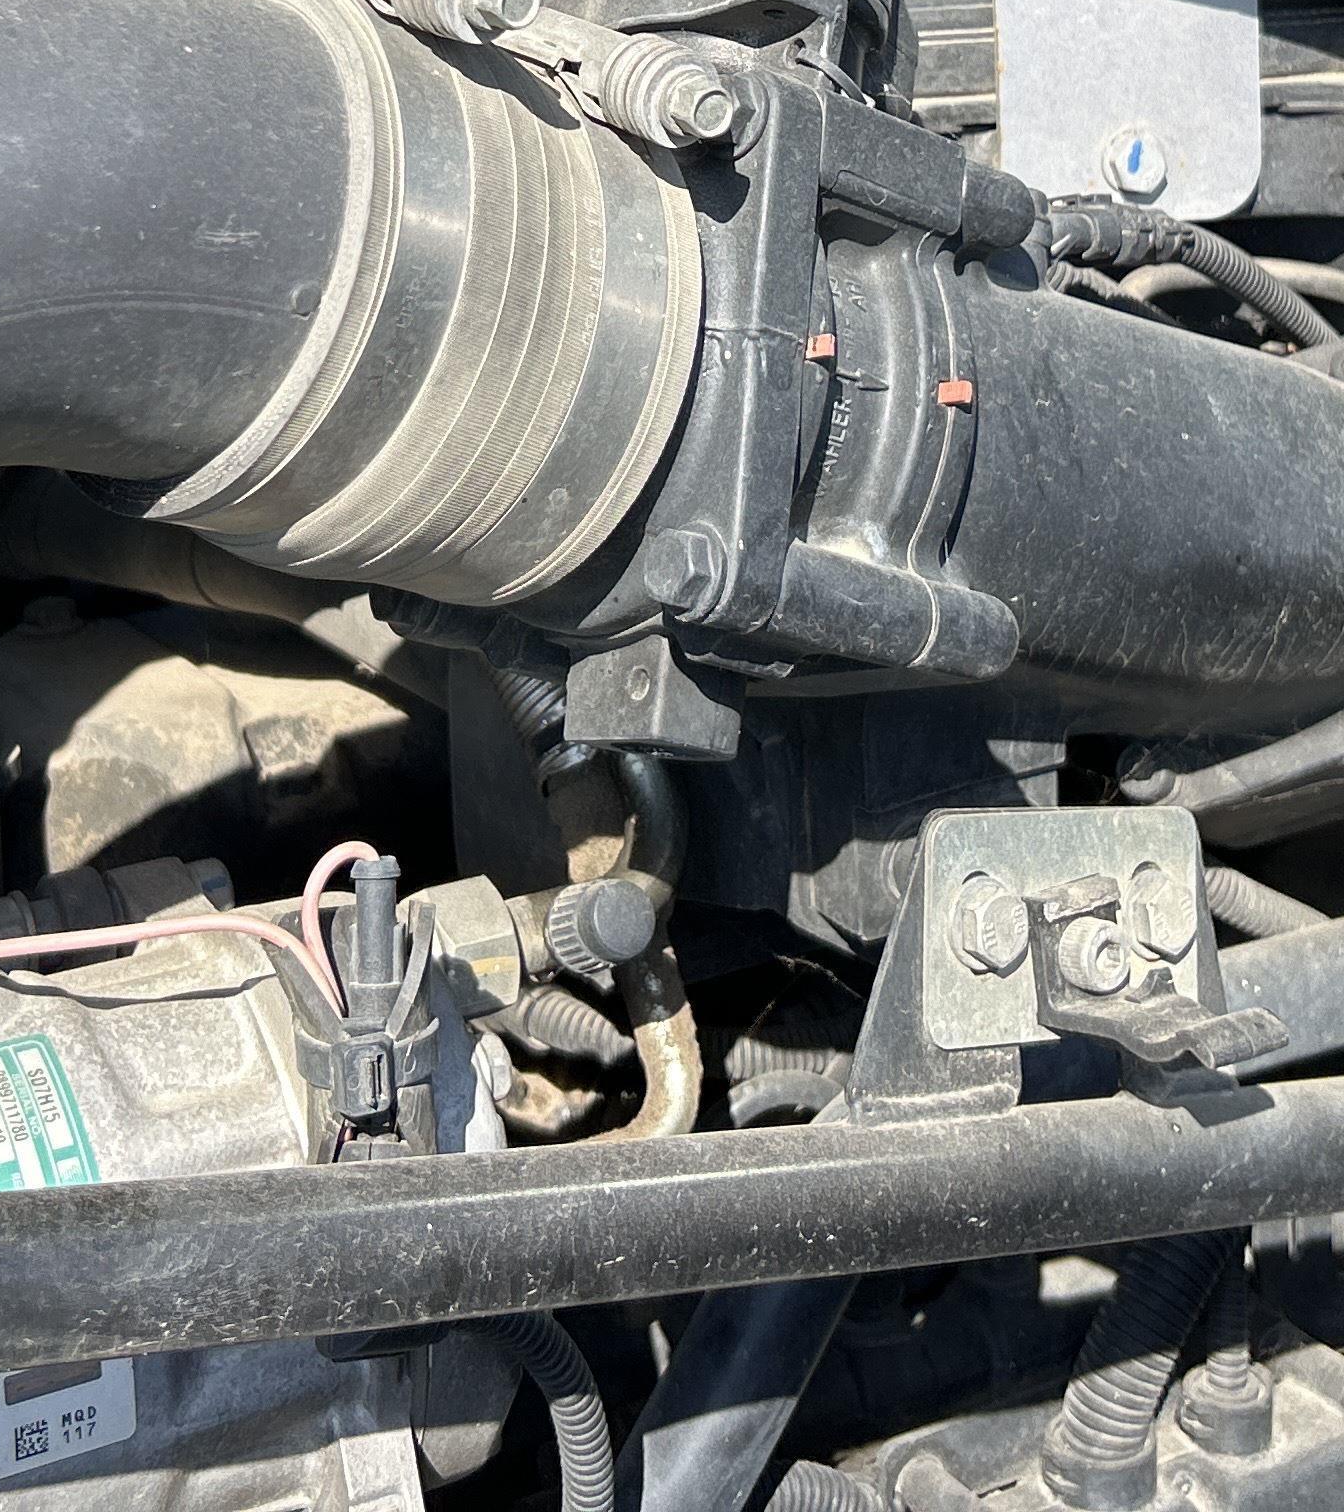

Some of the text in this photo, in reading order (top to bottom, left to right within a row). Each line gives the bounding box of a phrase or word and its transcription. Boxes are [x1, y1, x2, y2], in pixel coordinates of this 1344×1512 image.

[27, 1067, 62, 1124] SD7H15
[61, 1405, 98, 1427] MQD
[62, 1421, 97, 1444] 117
